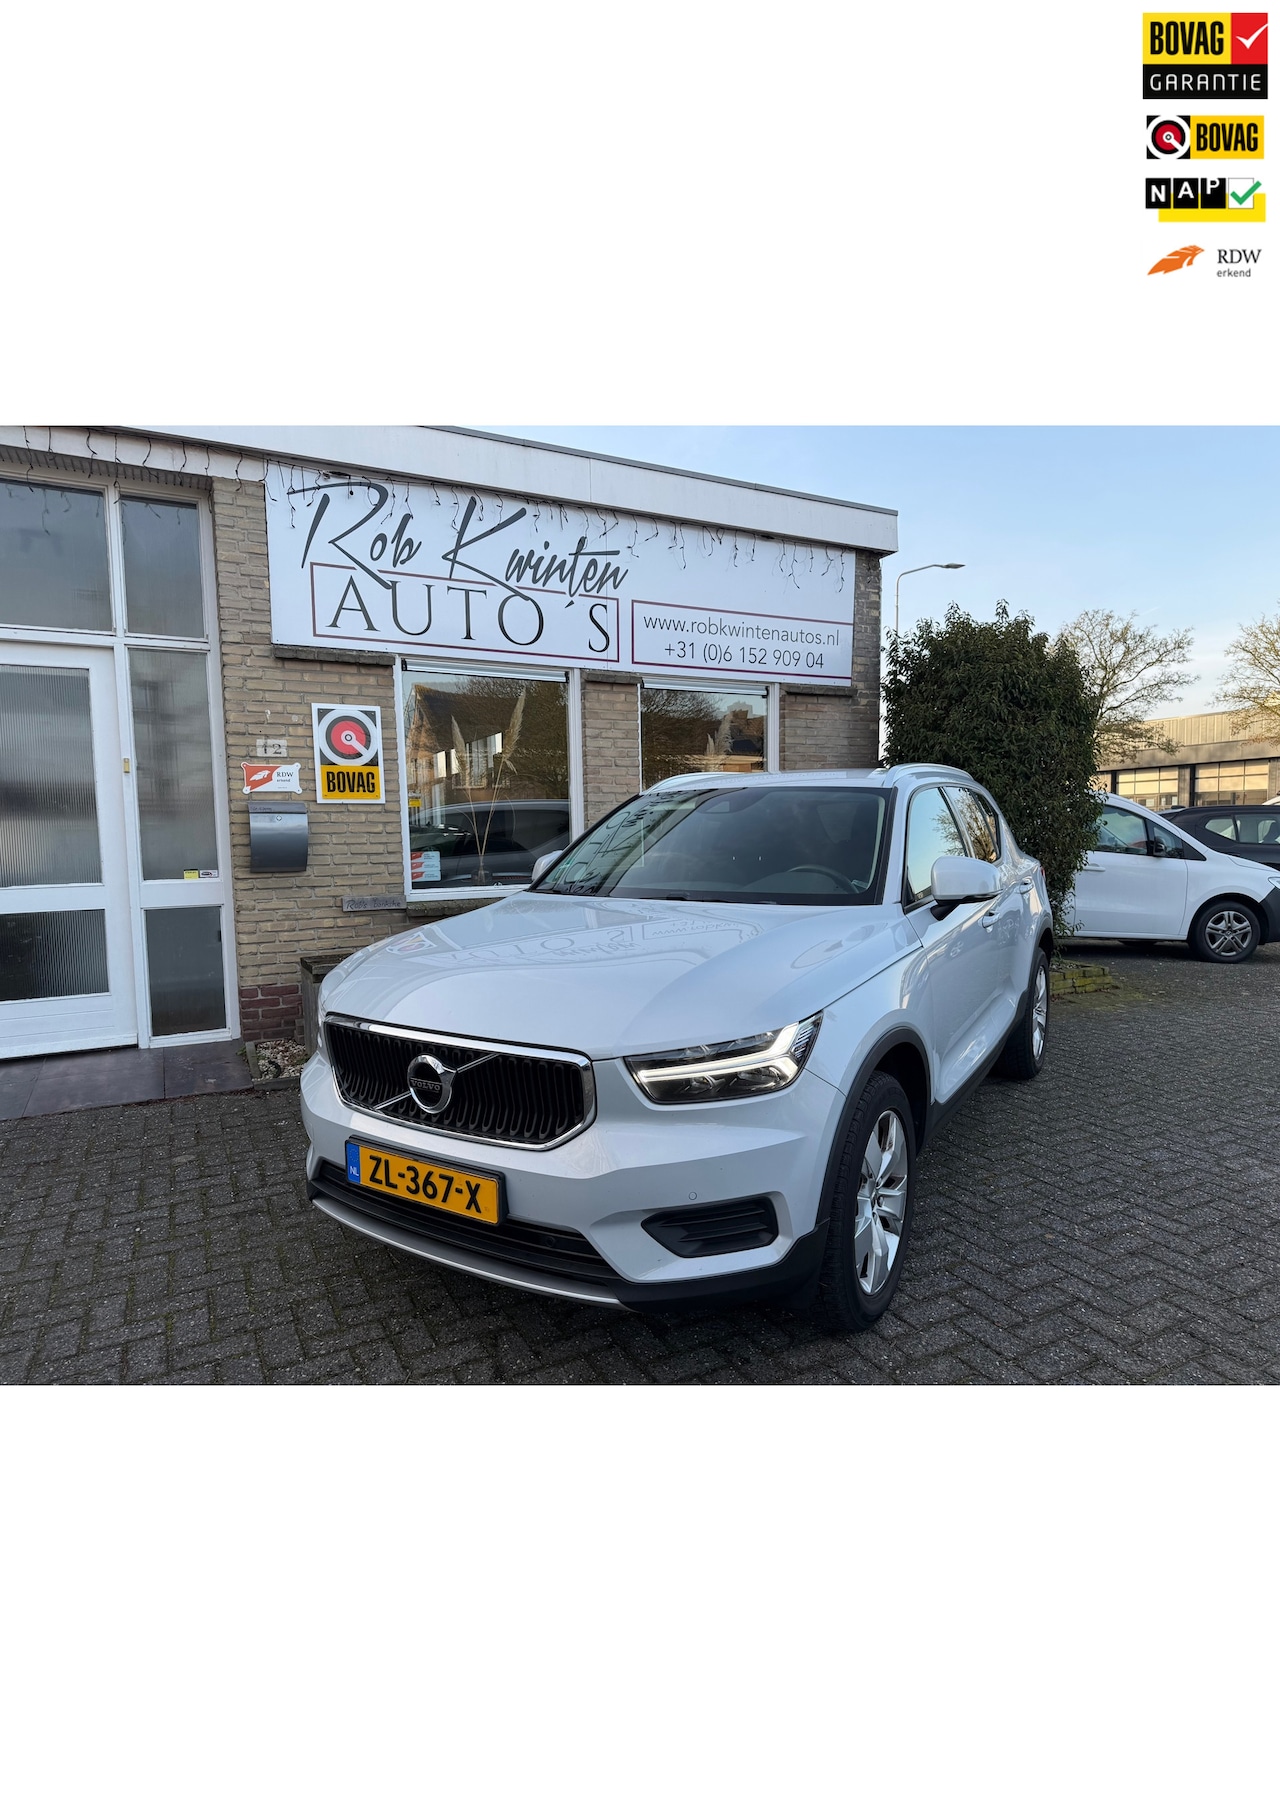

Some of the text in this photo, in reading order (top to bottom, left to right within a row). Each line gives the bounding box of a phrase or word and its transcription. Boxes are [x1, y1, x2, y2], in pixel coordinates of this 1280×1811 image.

[287, 481, 629, 601] Rob Kwinten
[643, 615, 840, 646] www.robkwintenautos.nl
[664, 641, 824, 669] +31 (0)6 152 909 04
[262, 743, 282, 755] 12
[326, 771, 376, 793] BOVAG
[410, 1078, 441, 1092] VOLVO
[350, 1154, 481, 1214] NL ZL-367-X
